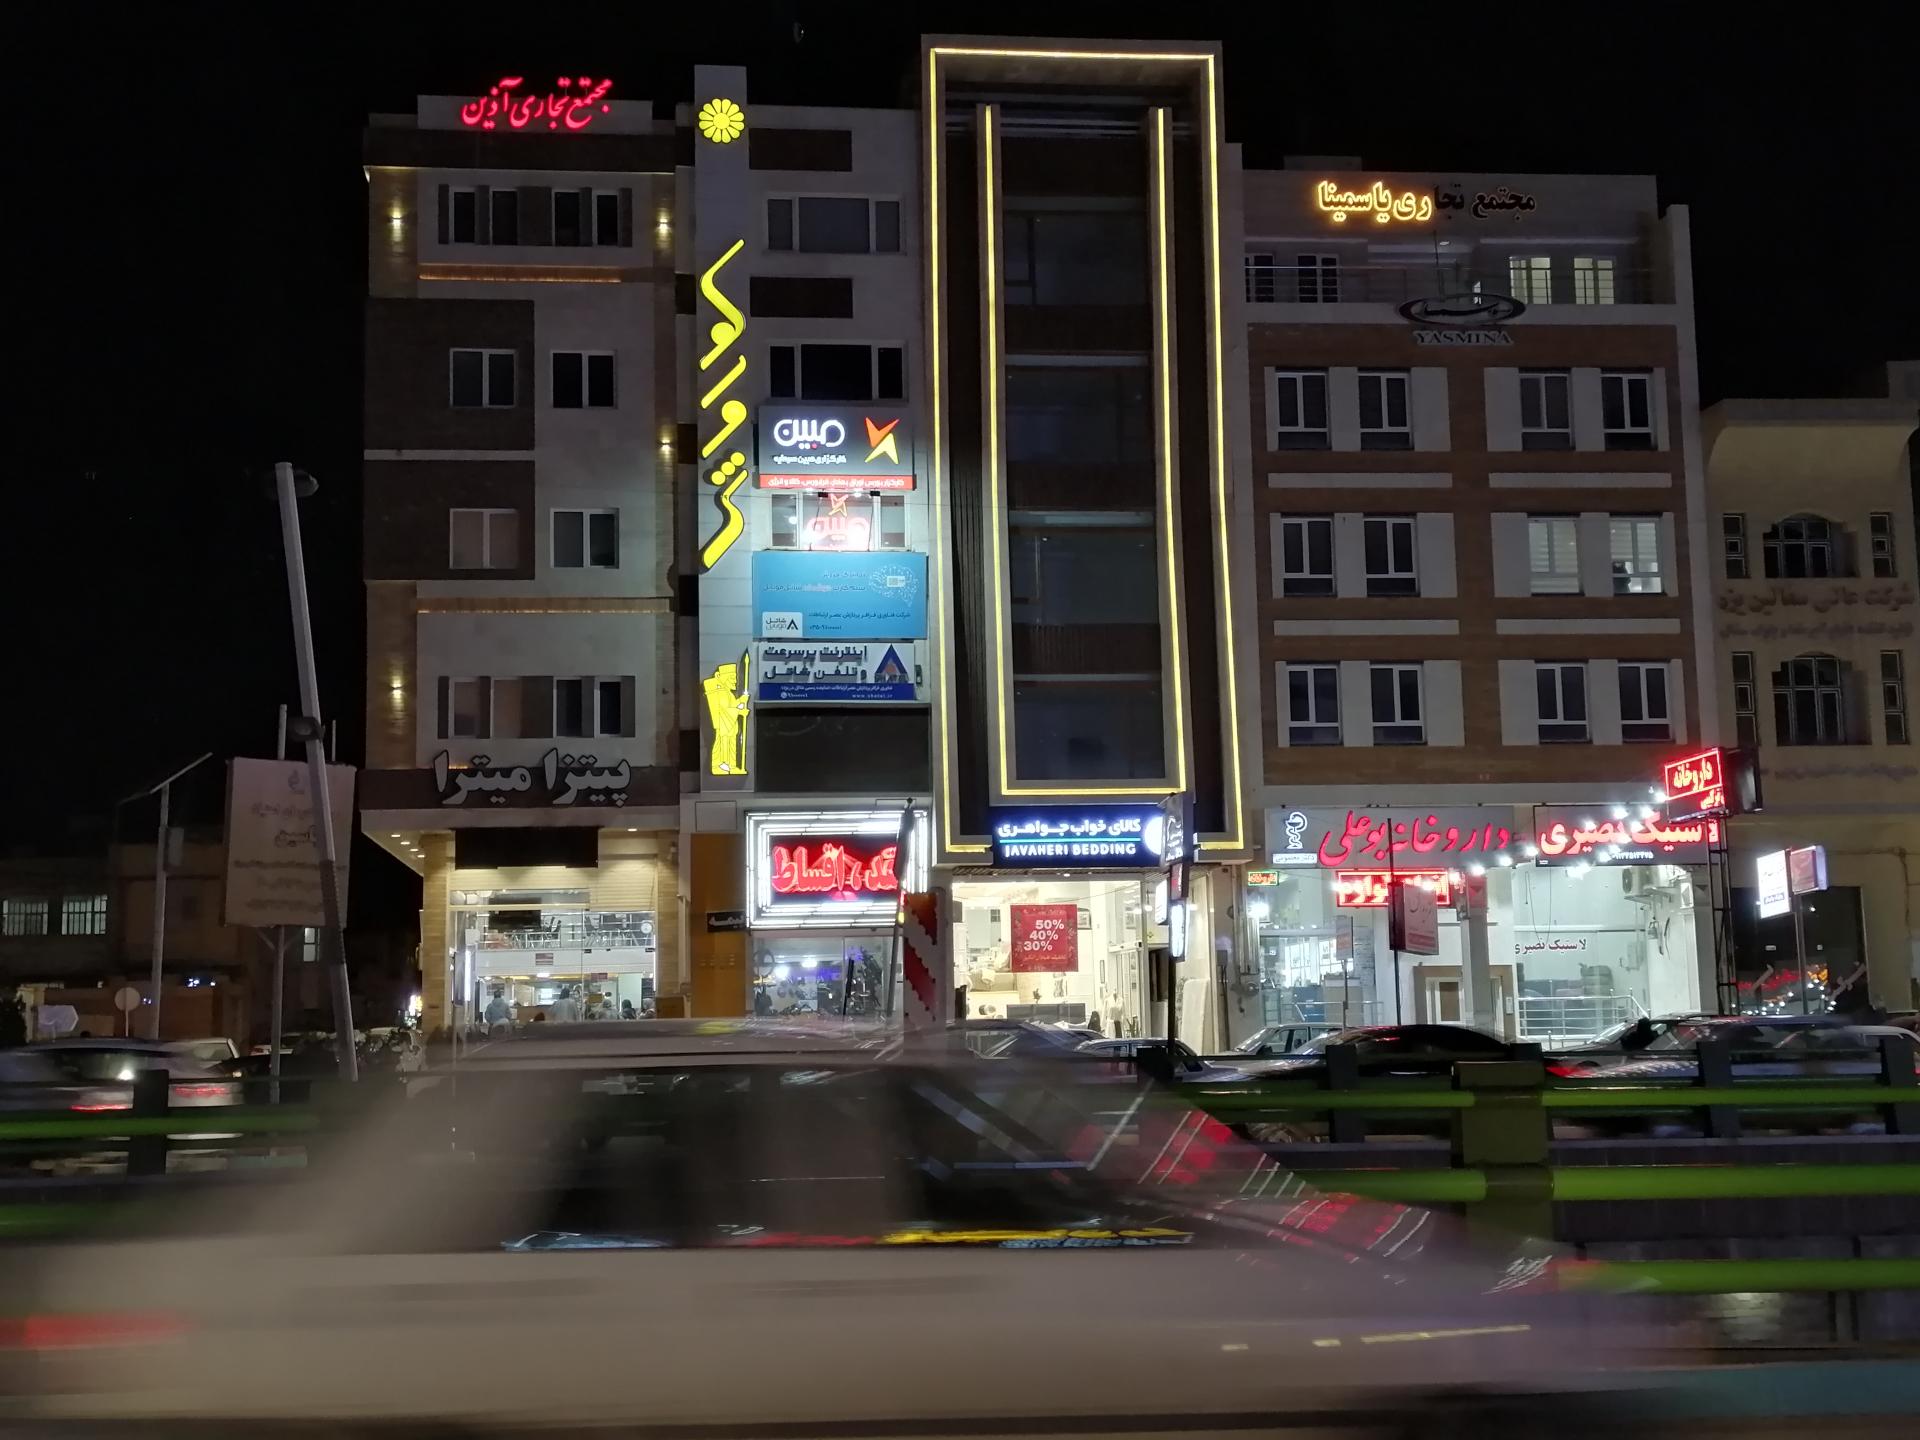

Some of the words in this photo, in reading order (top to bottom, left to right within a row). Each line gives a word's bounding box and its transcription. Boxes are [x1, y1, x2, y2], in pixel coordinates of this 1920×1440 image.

[462, 76, 524, 129] آذین
[510, 77, 571, 129] تجاری
[565, 77, 613, 130] مجتمع
[1317, 180, 1393, 223] یاسمینا
[1392, 183, 1465, 221] تجاری
[1471, 186, 1537, 221] مجتمع
[1414, 330, 1514, 345] YASMINA
[773, 419, 846, 450] مبین
[764, 646, 816, 659] پرسرعت
[820, 645, 867, 658] اینترنت
[764, 666, 810, 679] شاتل
[814, 666, 858, 679] تلفن
[860, 669, 867, 680] و
[433, 749, 532, 804] میترا
[543, 748, 631, 808] پیتزا
[1673, 758, 1713, 792] داروخانه
[998, 820, 1070, 837] جواهری
[1071, 818, 1106, 834] خواب
[1108, 818, 1141, 835] کالای
[1391, 815, 1510, 852] داروخانه
[1318, 810, 1387, 867] بوعلی
[1005, 843, 1069, 857] JAVAHERI
[1072, 843, 1137, 856] BEDDING
[771, 843, 845, 892] اقساط
[1035, 919, 1064, 930] 50%
[1029, 930, 1058, 940] 40%
[1023, 941, 1052, 951] 30%
[1514, 937, 1546, 955] نصیری
[1549, 939, 1587, 954] لاستیک
